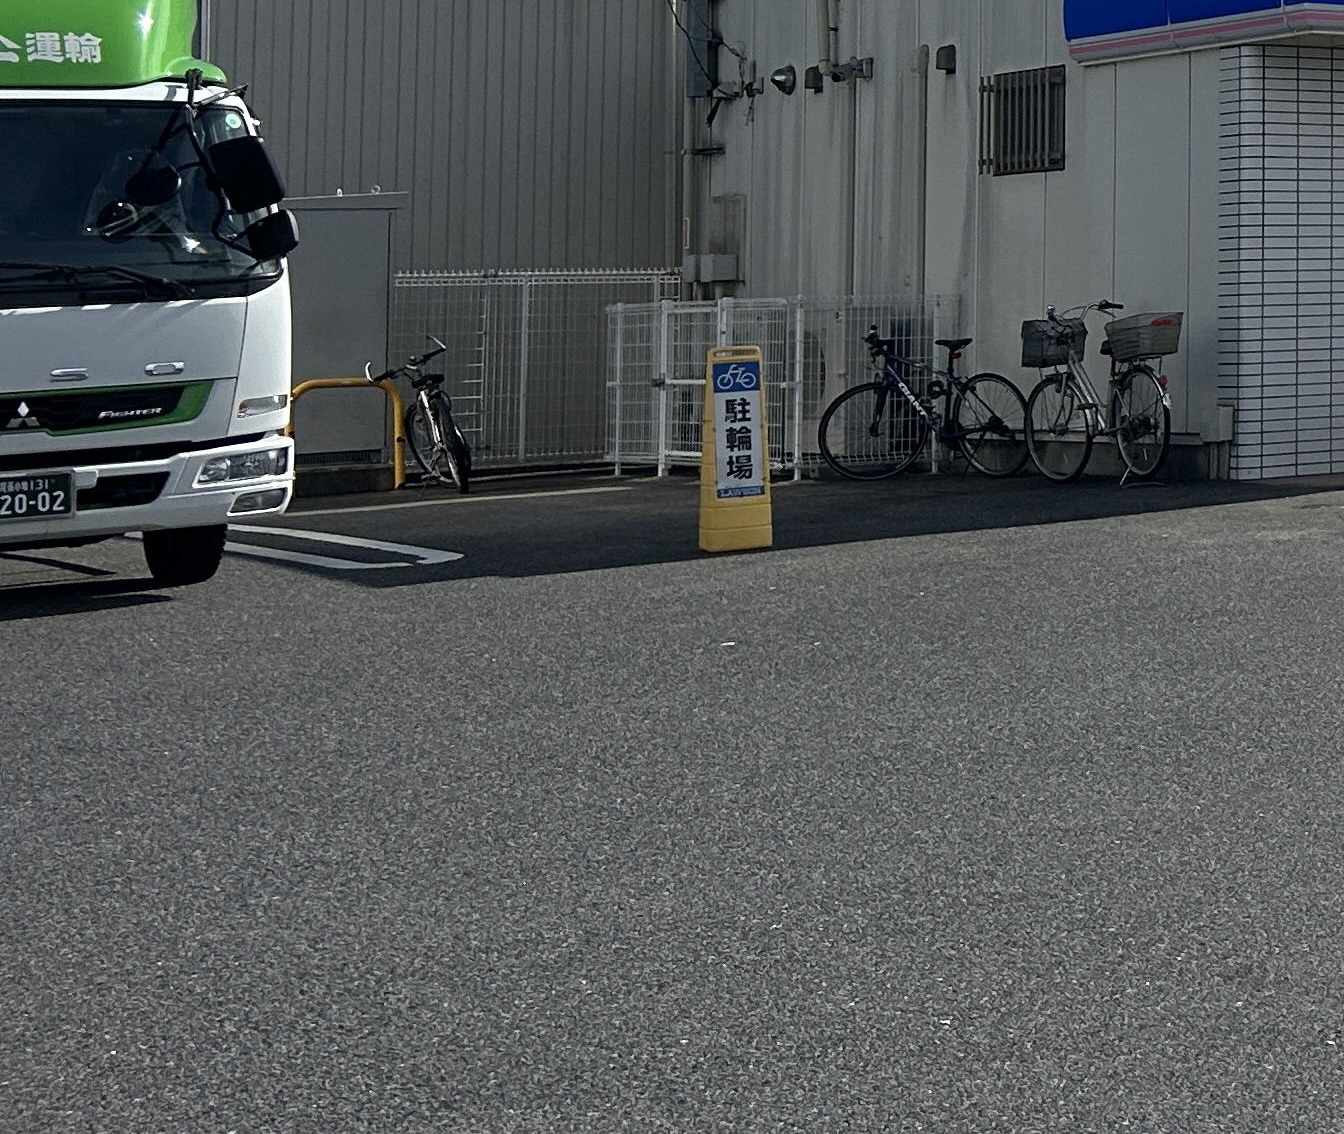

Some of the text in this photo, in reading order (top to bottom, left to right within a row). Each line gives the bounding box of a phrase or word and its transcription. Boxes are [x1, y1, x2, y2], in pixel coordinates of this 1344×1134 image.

[898, 382, 927, 416] GIANT
[724, 397, 753, 480] 駐輪場
[0, 490, 66, 515] 20-02
